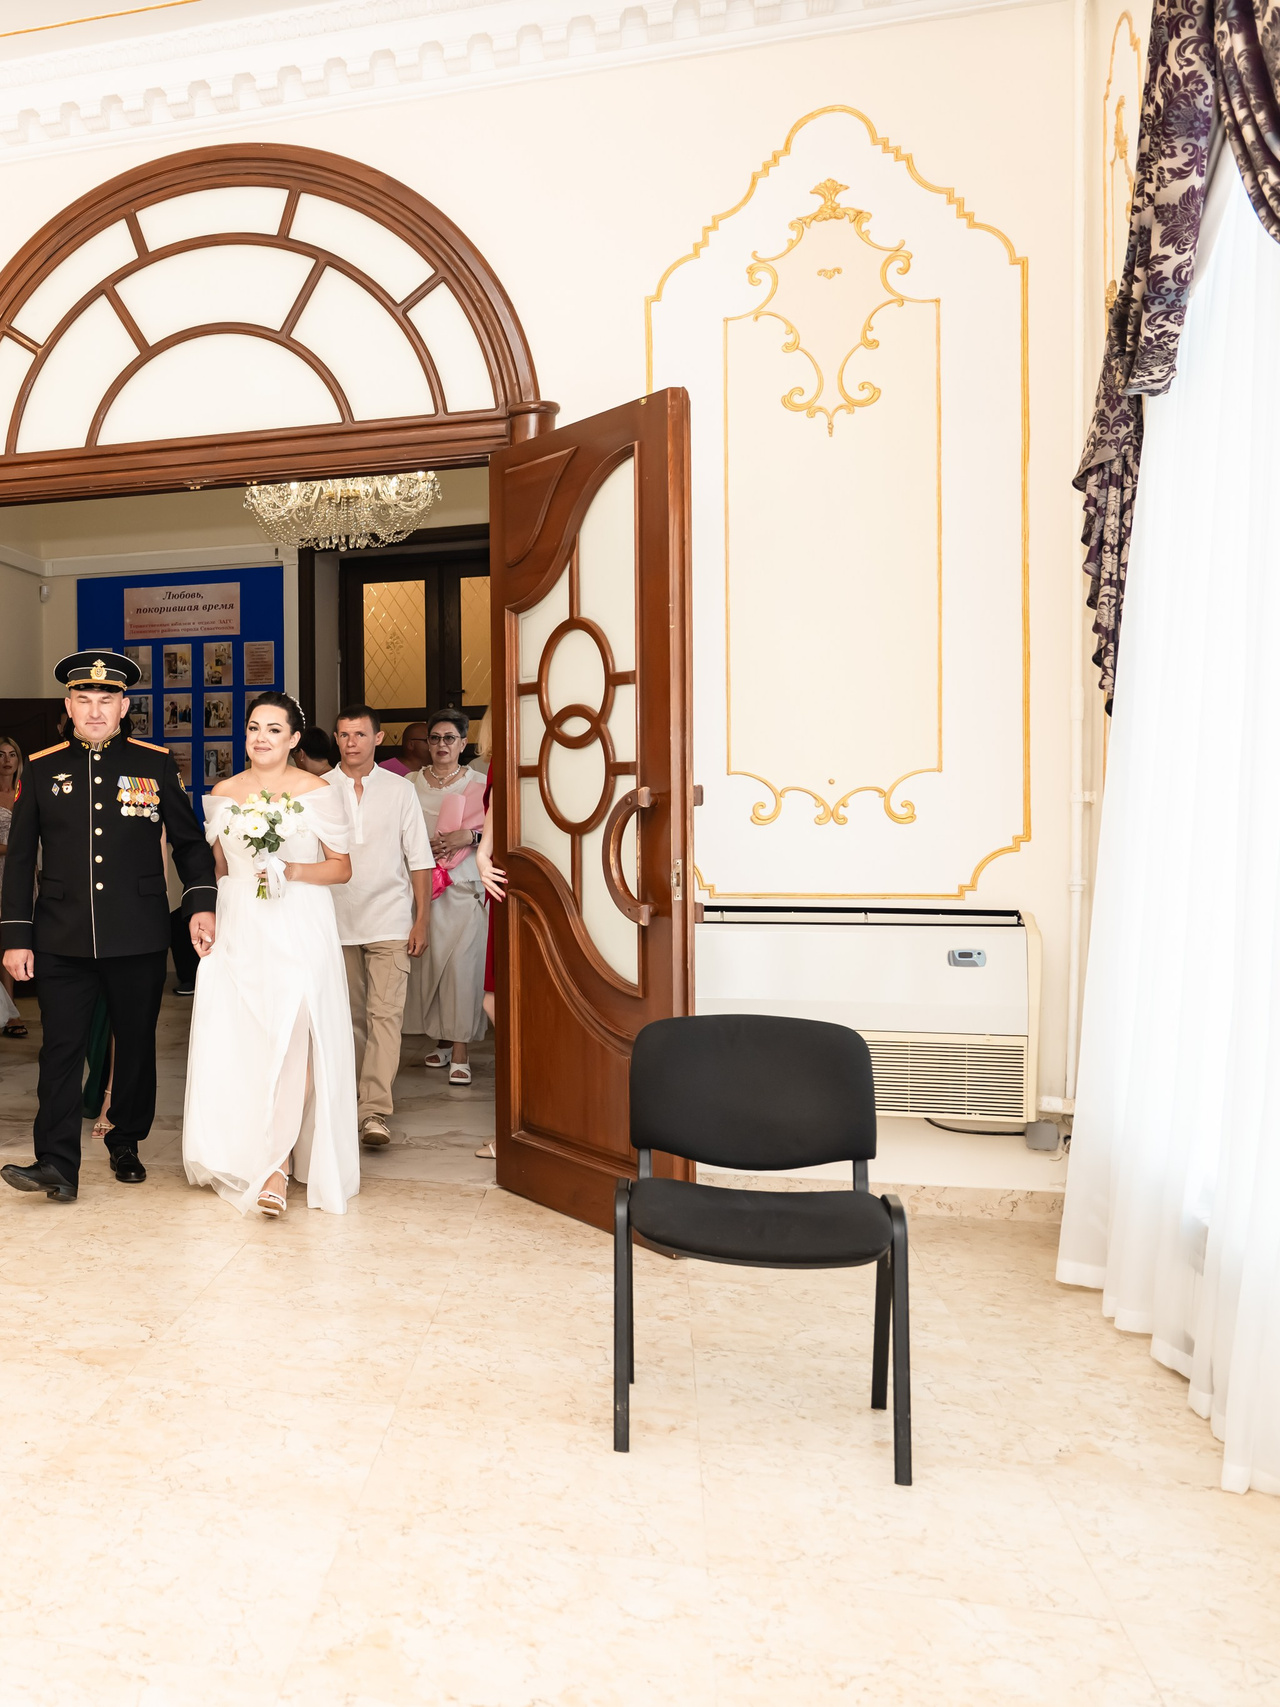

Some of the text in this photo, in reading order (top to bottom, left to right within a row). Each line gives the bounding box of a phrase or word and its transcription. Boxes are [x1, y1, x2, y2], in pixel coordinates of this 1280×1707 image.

[163, 591, 204, 601] Любовь,
[136, 603, 234, 614] покорившая время
